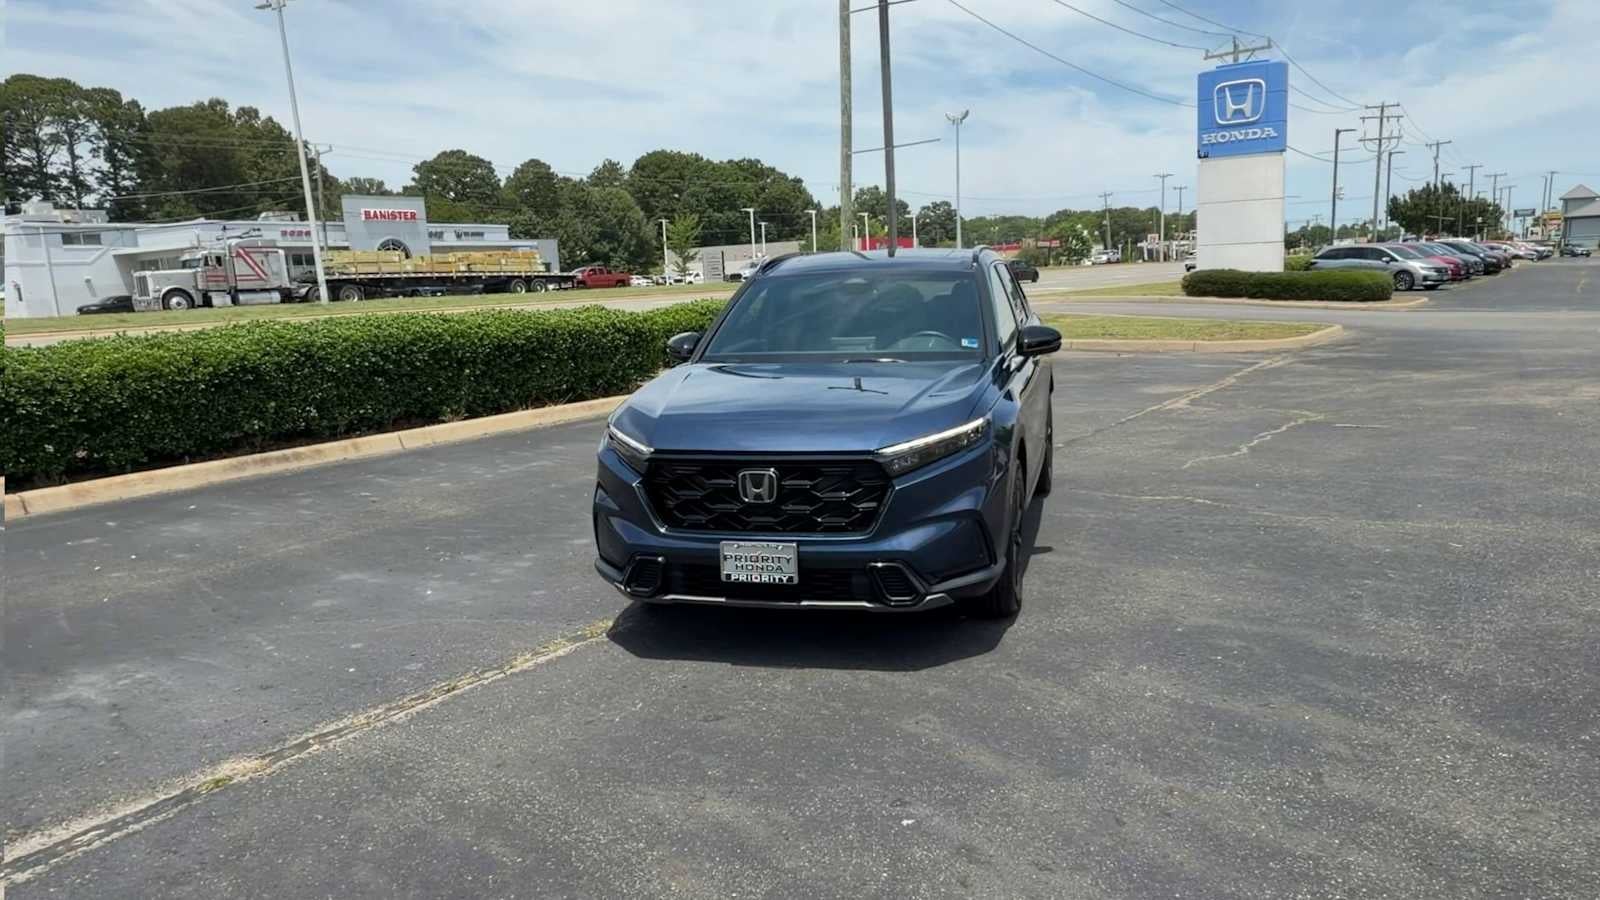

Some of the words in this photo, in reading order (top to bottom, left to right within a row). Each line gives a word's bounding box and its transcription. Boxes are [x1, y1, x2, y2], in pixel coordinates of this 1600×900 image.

[1202, 127, 1278, 144] HONDA
[364, 209, 416, 220] BANISTER
[723, 553, 792, 564] PRIORITY
[735, 562, 784, 573] HONDA
[731, 573, 788, 584] PRIORITY
